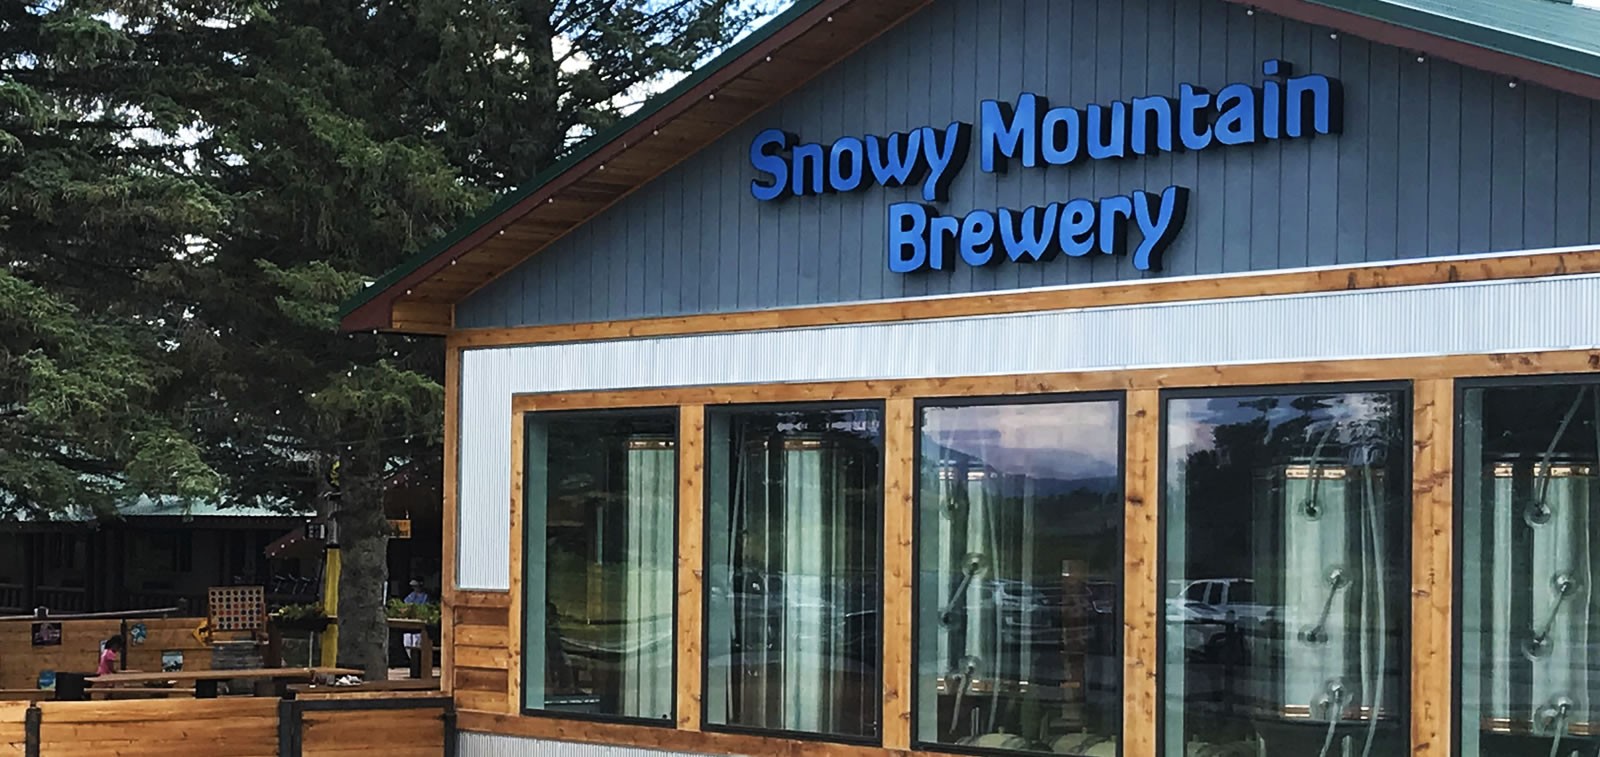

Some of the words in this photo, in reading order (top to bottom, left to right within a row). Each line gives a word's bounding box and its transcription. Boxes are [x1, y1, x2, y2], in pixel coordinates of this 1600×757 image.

[750, 122, 967, 201] Snowy
[980, 59, 1338, 173] Mountain
[889, 186, 1185, 272] Brewery
